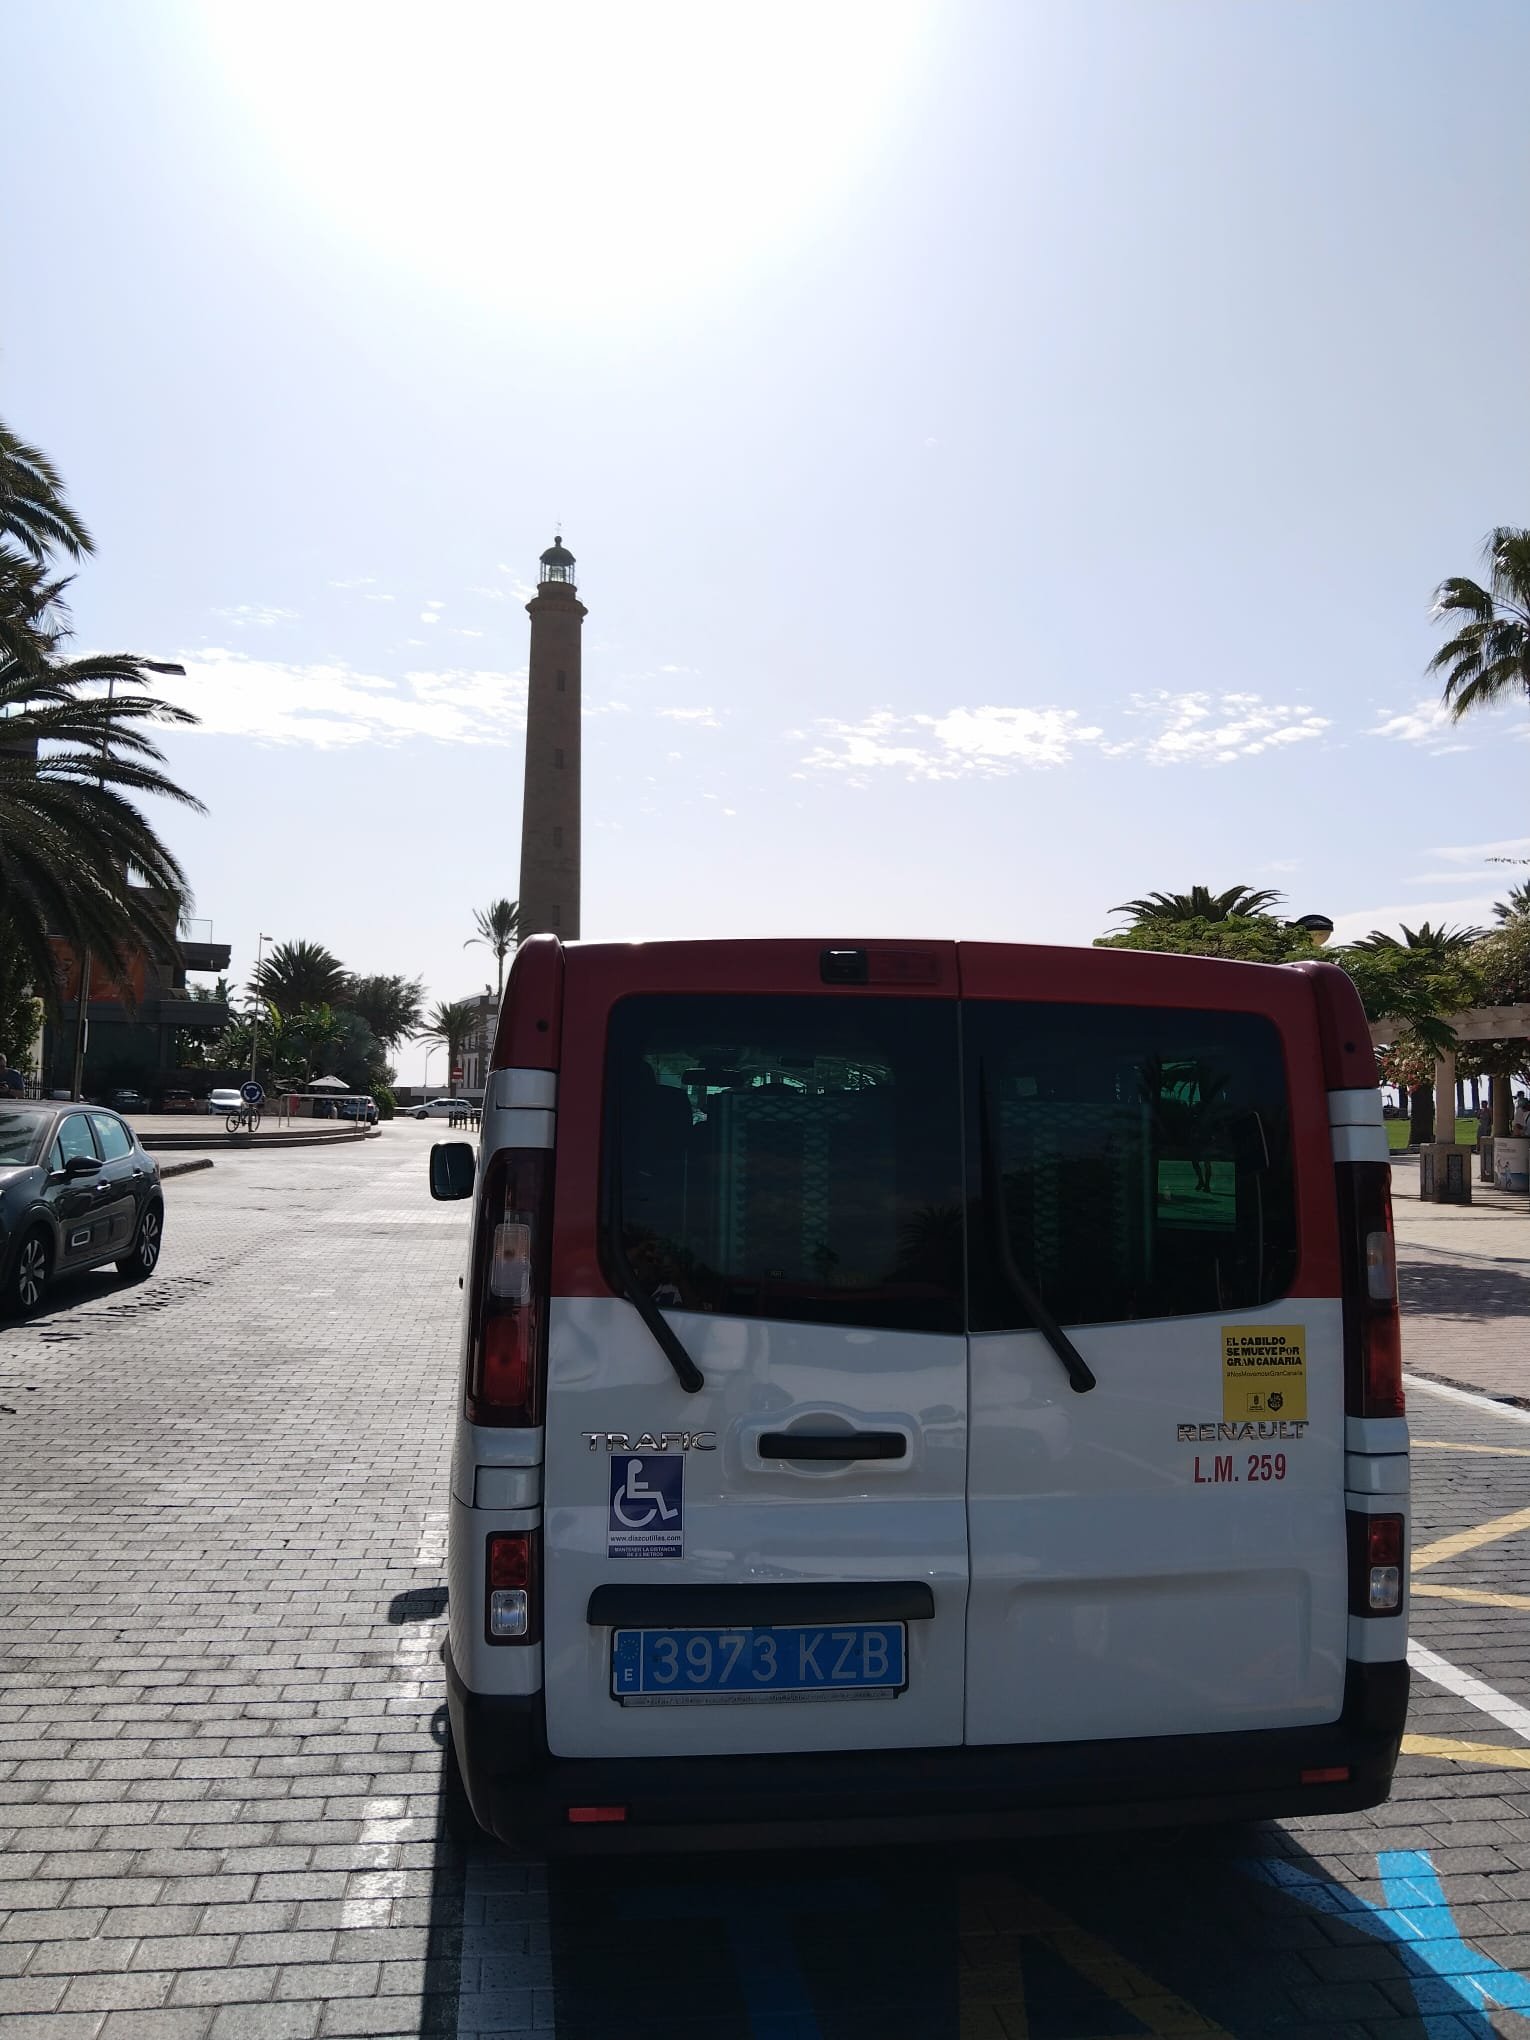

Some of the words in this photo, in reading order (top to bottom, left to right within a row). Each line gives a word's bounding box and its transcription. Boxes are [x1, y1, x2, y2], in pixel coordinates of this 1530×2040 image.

[1227, 1337, 1239, 1346] EL
[1241, 1336, 1286, 1346] CABILDO
[1227, 1347, 1240, 1357] SE
[1241, 1347, 1278, 1356] MUEVE
[1279, 1346, 1300, 1356] POR
[1227, 1357, 1255, 1367] GRAN
[1256, 1357, 1302, 1366] CANARIA
[1176, 1421, 1310, 1441] RENAULT
[581, 1431, 717, 1451] TRAFIC
[1194, 1455, 1239, 1483] L.M.
[1247, 1453, 1286, 1481] 259
[652, 1635, 779, 1685] 3973
[799, 1631, 890, 1681] KZB
[624, 1668, 633, 1682] E
